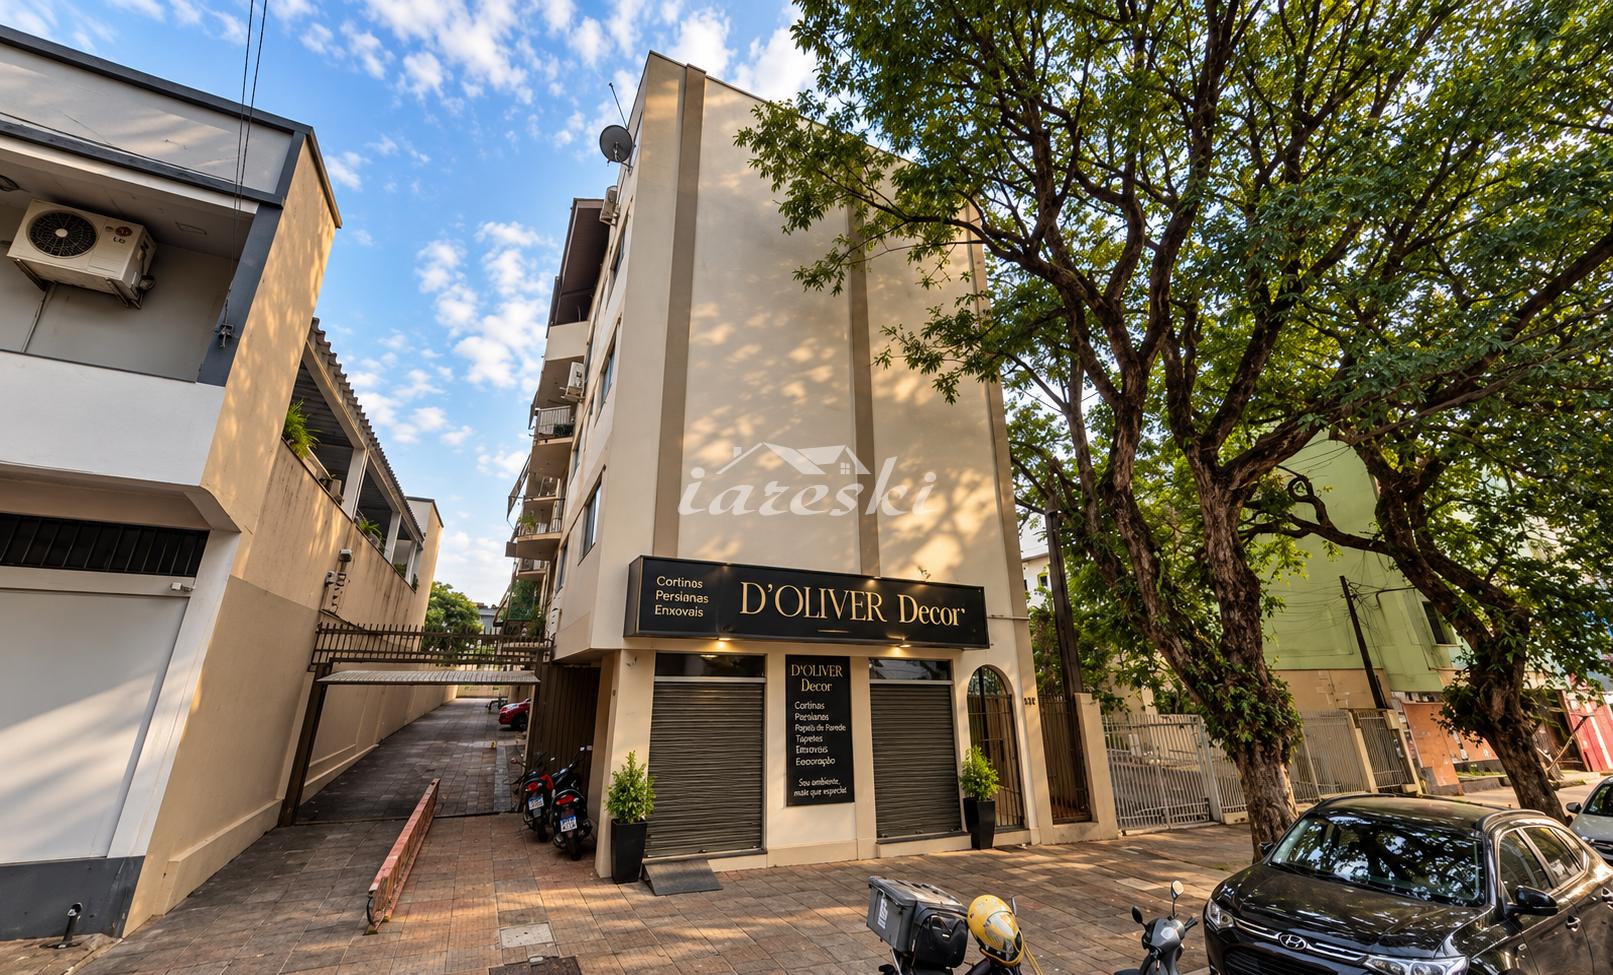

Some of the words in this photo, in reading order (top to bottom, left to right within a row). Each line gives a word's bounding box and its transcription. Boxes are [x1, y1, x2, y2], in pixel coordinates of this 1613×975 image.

[739, 581, 887, 622] D'OLIVER
[655, 604, 704, 618] Enxovais
[791, 664, 843, 678] D'OLIVER
[801, 678, 833, 692] Decor
